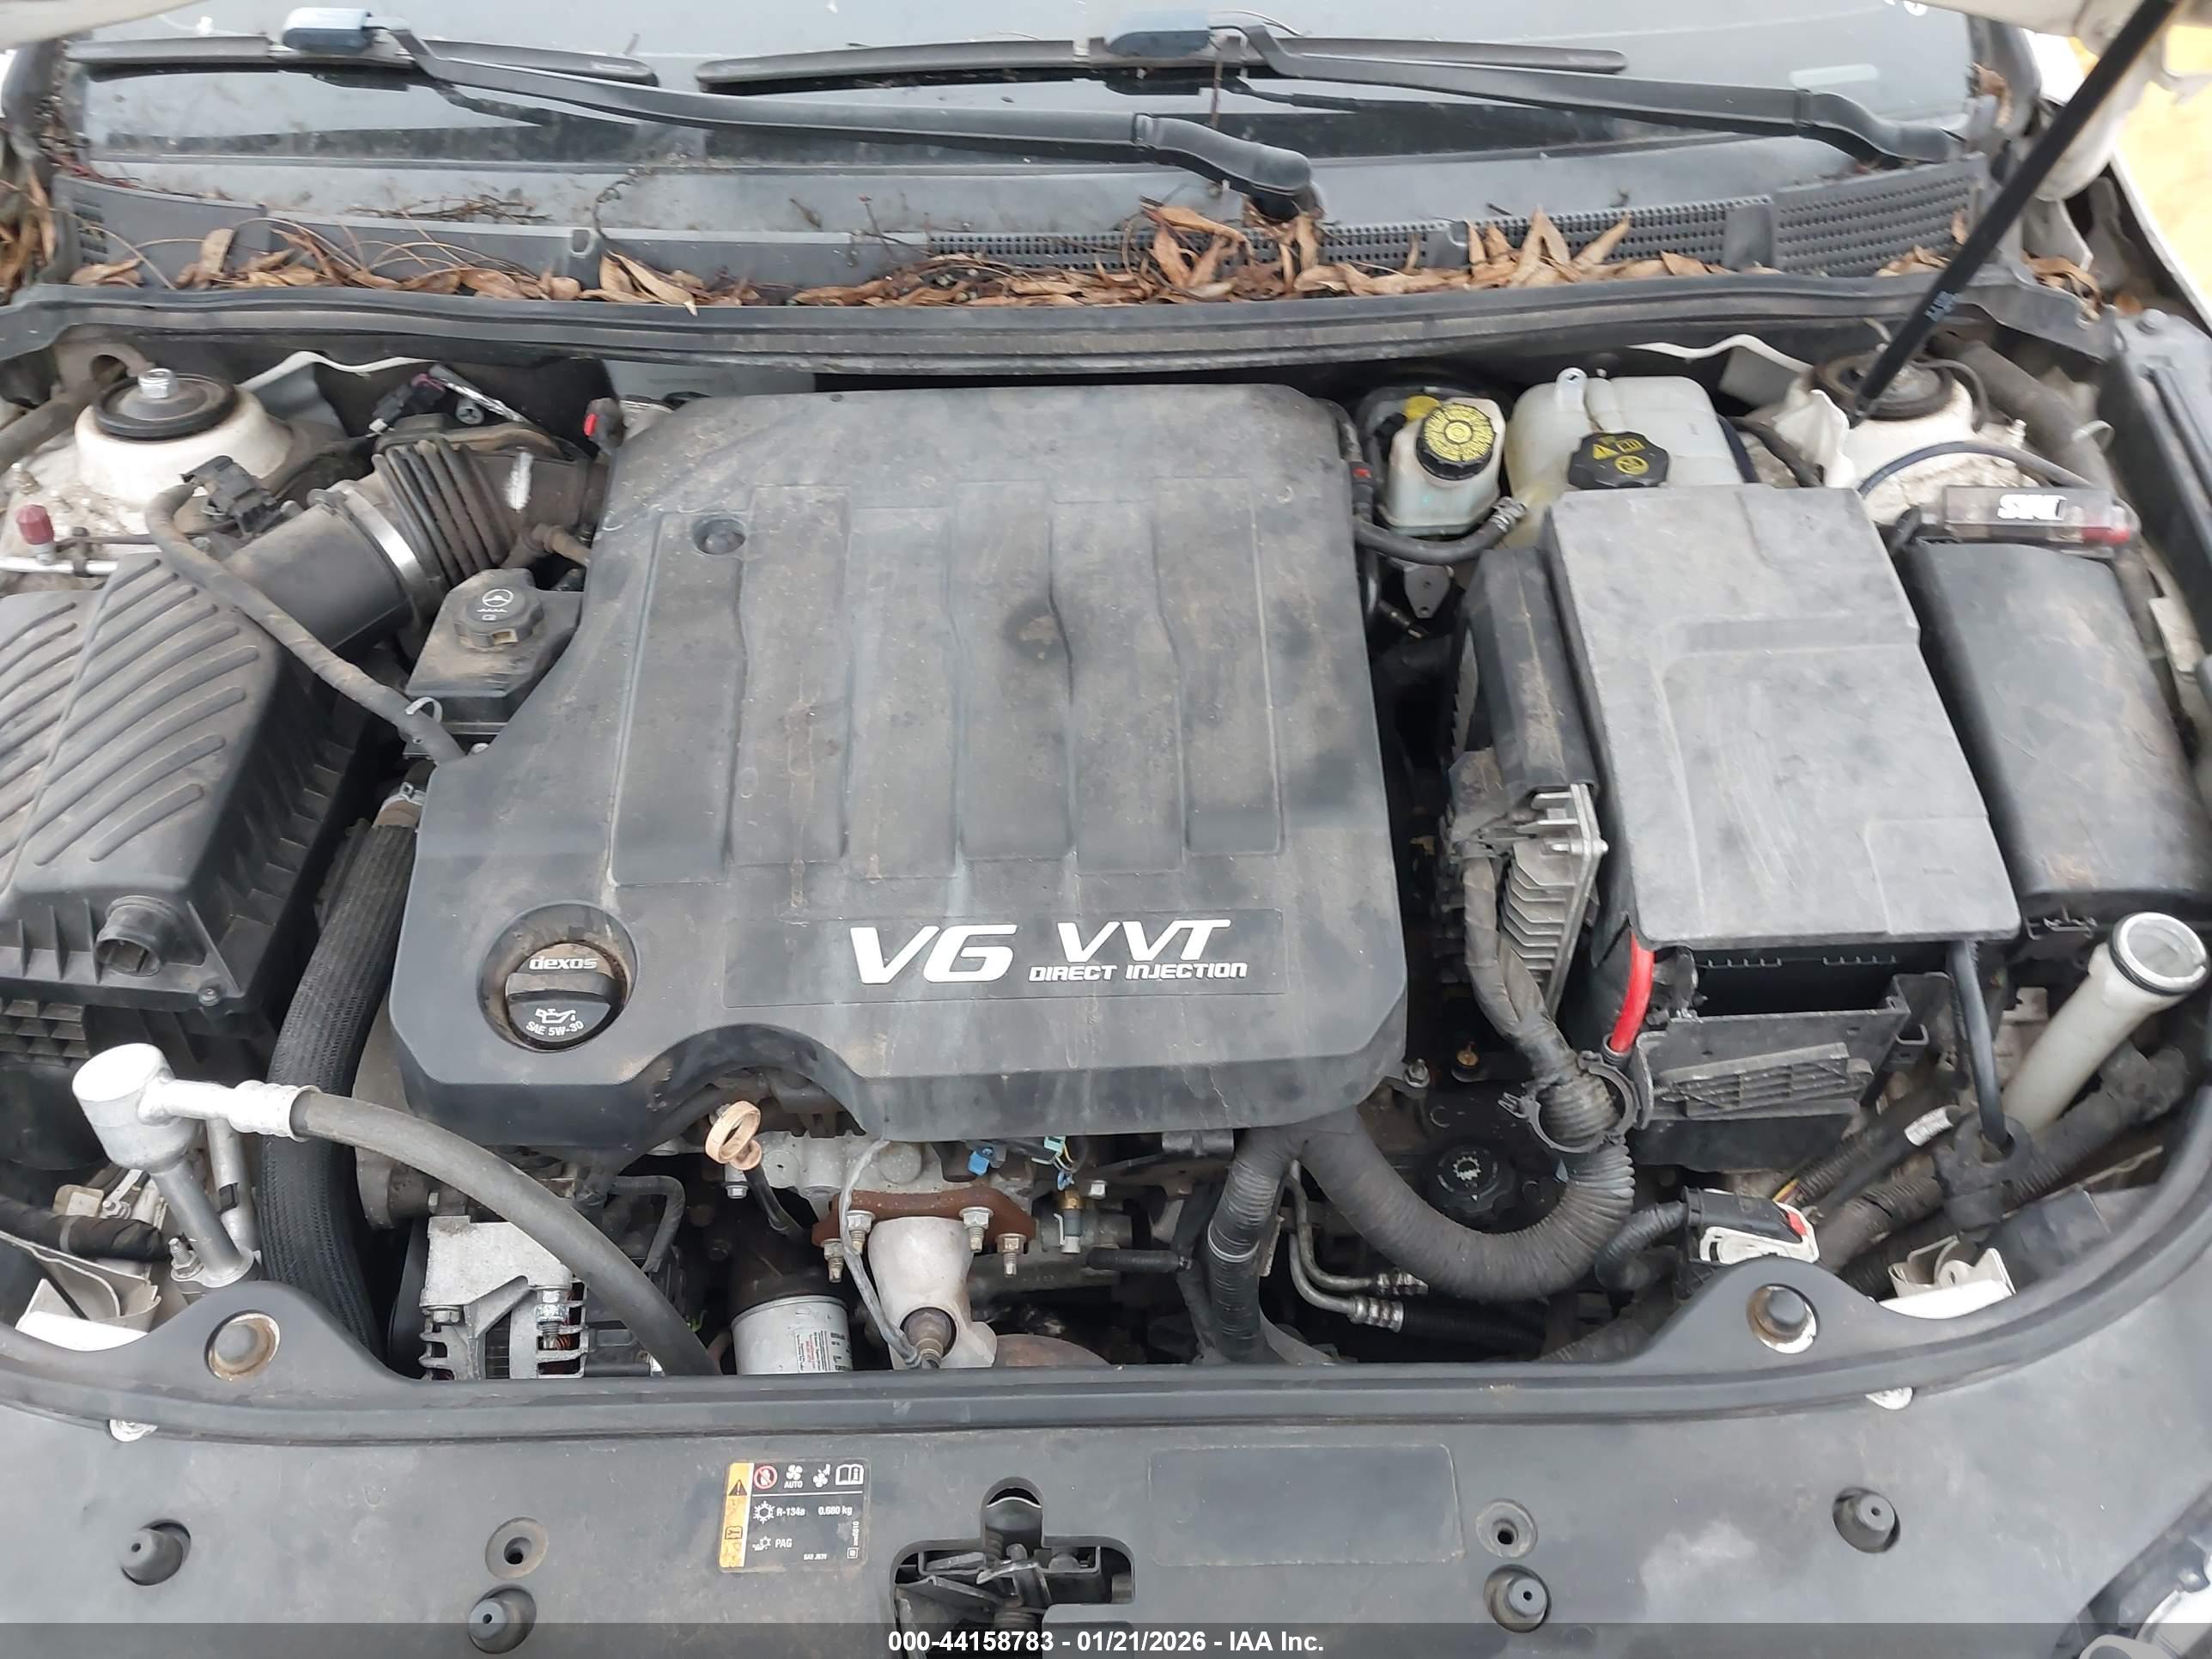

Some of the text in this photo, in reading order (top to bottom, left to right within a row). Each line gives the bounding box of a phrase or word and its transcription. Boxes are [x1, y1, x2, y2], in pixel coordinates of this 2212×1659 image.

[849, 919, 1231, 985] V6 VVT
[528, 957, 598, 969] dexos
[1028, 962, 1249, 982] DIRECT INJECTION
[526, 1020, 584, 1036] SAE 5W-30
[842, 1506, 853, 1516] kg
[775, 1539, 793, 1548] PAG
